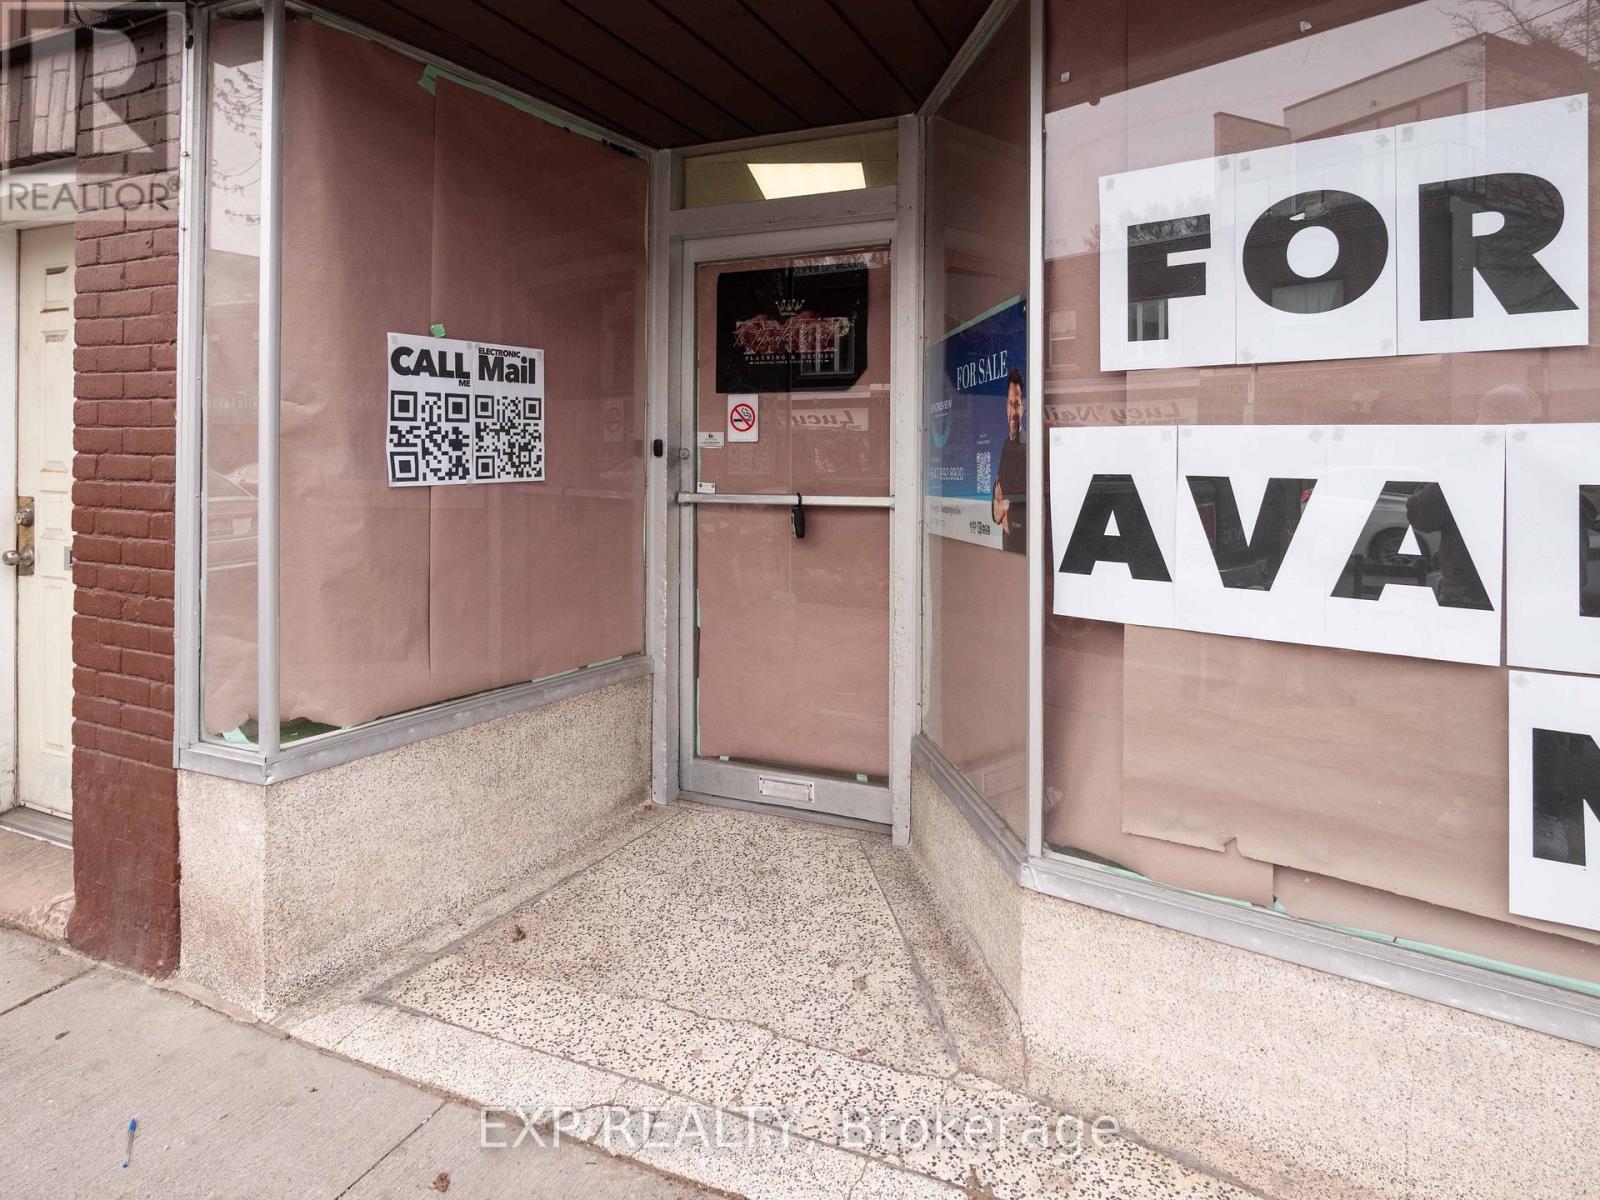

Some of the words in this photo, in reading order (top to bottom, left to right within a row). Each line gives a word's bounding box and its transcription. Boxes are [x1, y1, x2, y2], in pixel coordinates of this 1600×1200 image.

[1127, 172, 1579, 343] FOR
[391, 346, 471, 379] CALL
[478, 347, 521, 358] ELECTRONIC
[458, 379, 471, 387] ME
[478, 355, 536, 385] Mail
[956, 361, 977, 391] FOR
[978, 349, 1009, 385] SALE
